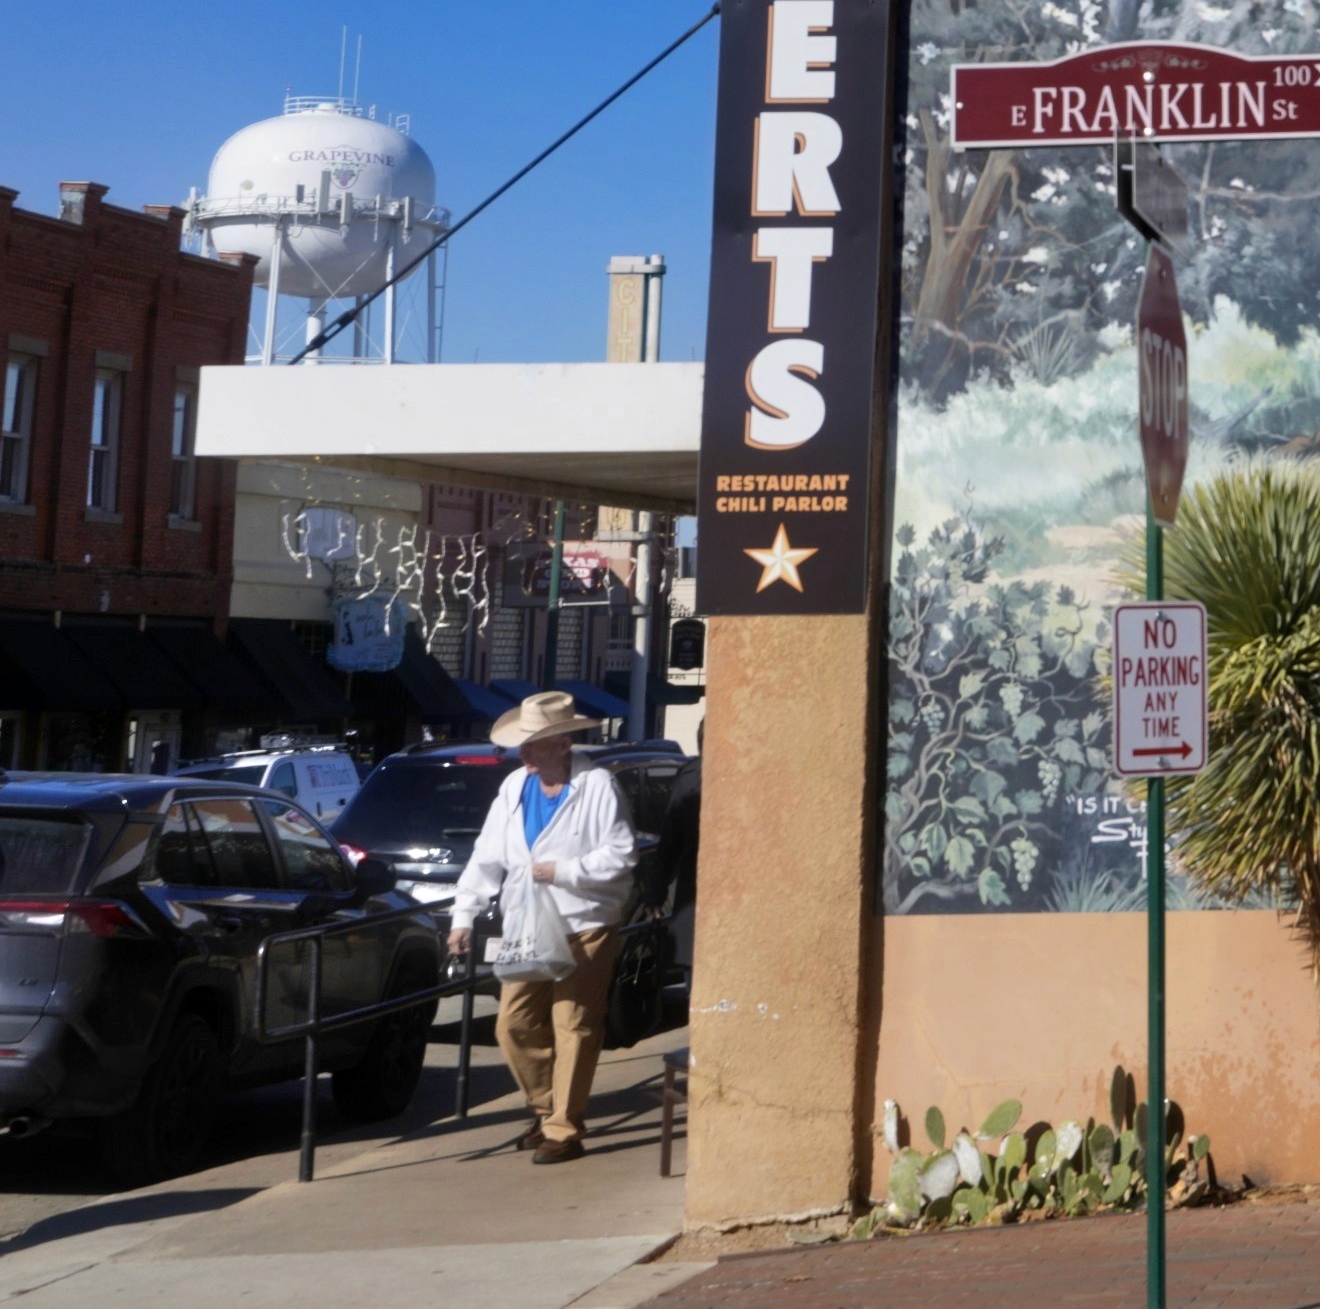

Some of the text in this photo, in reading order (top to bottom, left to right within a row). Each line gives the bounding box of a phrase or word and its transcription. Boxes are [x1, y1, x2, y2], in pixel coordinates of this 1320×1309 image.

[1272, 66, 1311, 87] 100
[1011, 81, 1299, 133] E FRANKLIN St
[288, 150, 396, 167] GRAPEVINE
[1142, 326, 1187, 439] STOP
[716, 474, 850, 492] RESTAURANT
[716, 496, 849, 512] CHILI PARLOR
[1144, 619, 1177, 648] NO
[1122, 656, 1200, 687] PARKING
[1144, 692, 1178, 712] ANY
[1142, 717, 1181, 737] TIME
[1103, 797, 1121, 813] IT
